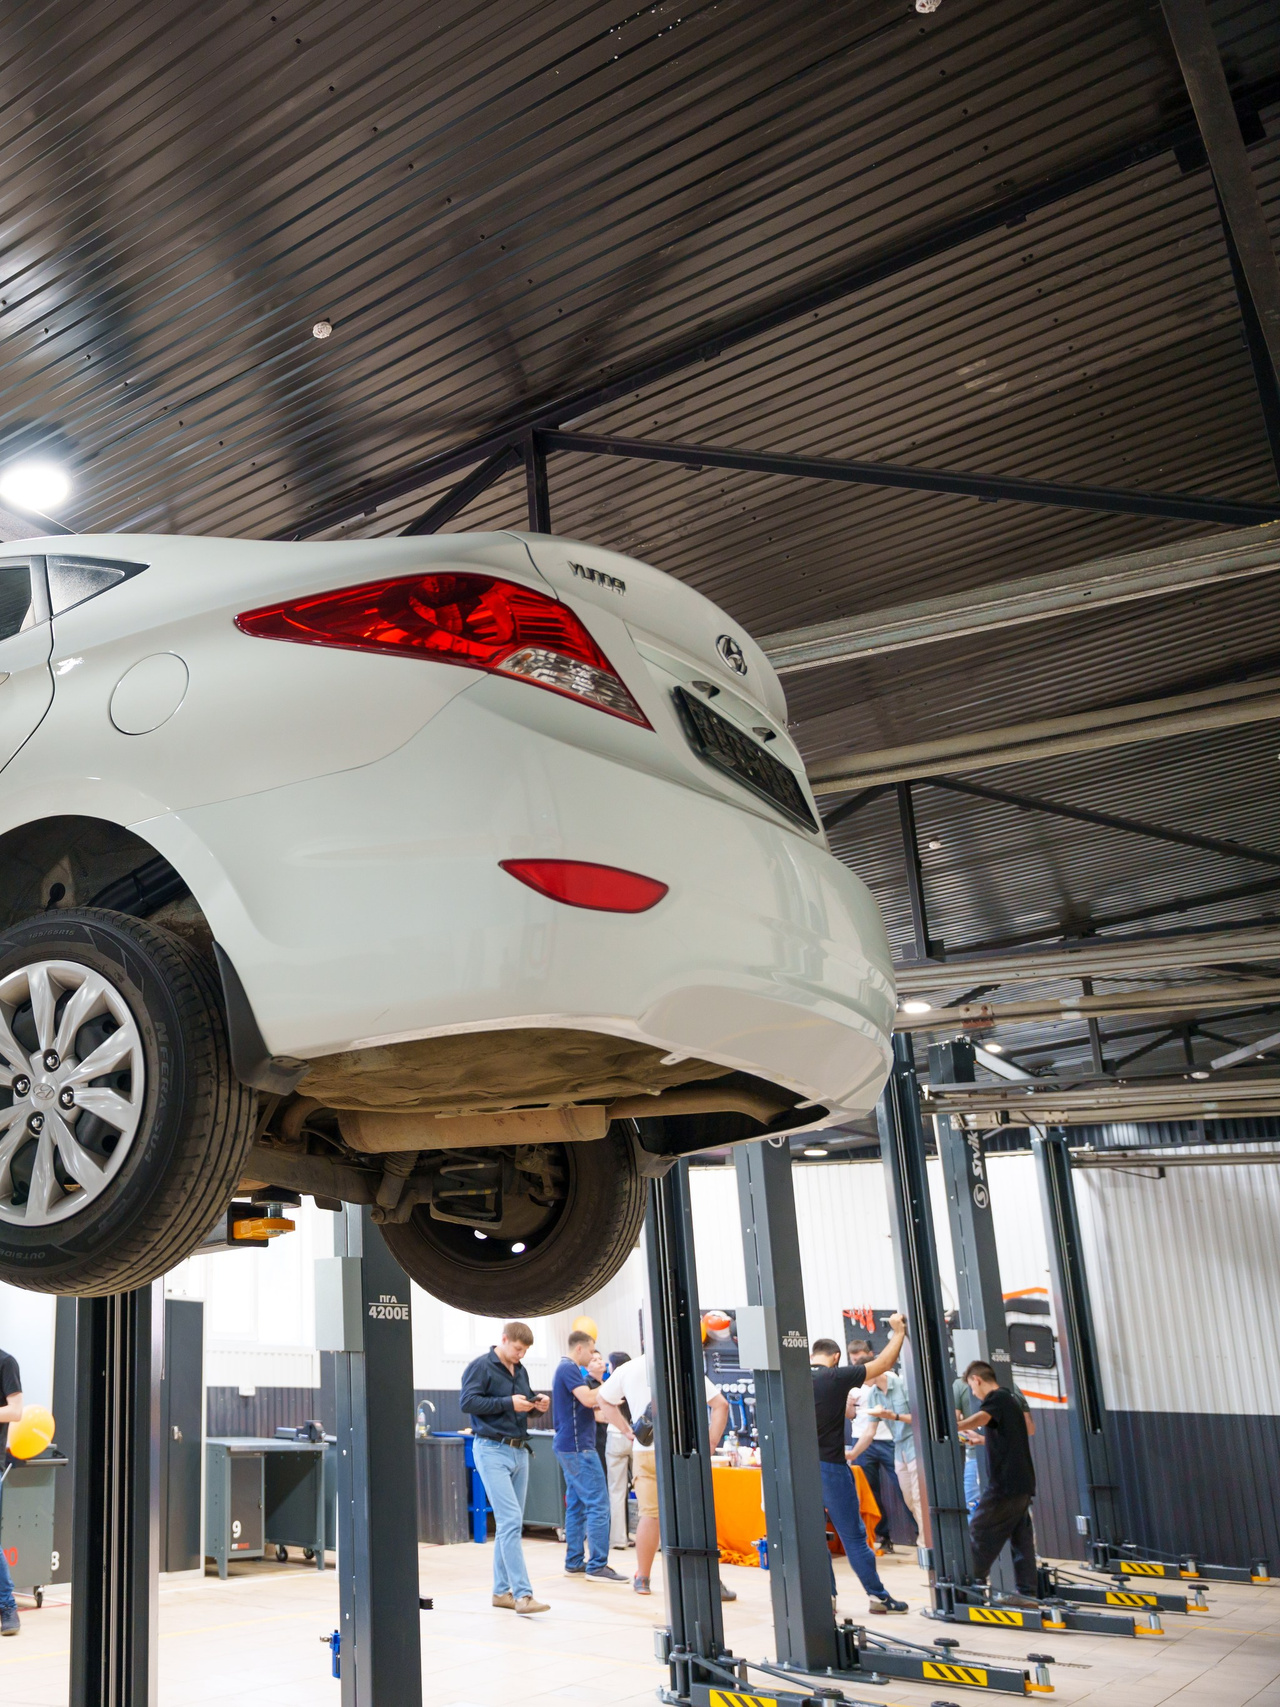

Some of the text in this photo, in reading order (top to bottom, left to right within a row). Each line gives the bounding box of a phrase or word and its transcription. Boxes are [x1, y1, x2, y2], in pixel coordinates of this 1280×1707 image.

[379, 1294, 398, 1303] ПГА
[368, 1306, 409, 1320] 4200E
[782, 1338, 808, 1348] 4200E
[232, 1520, 242, 1539] 9
[50, 1550, 60, 1571] 8
